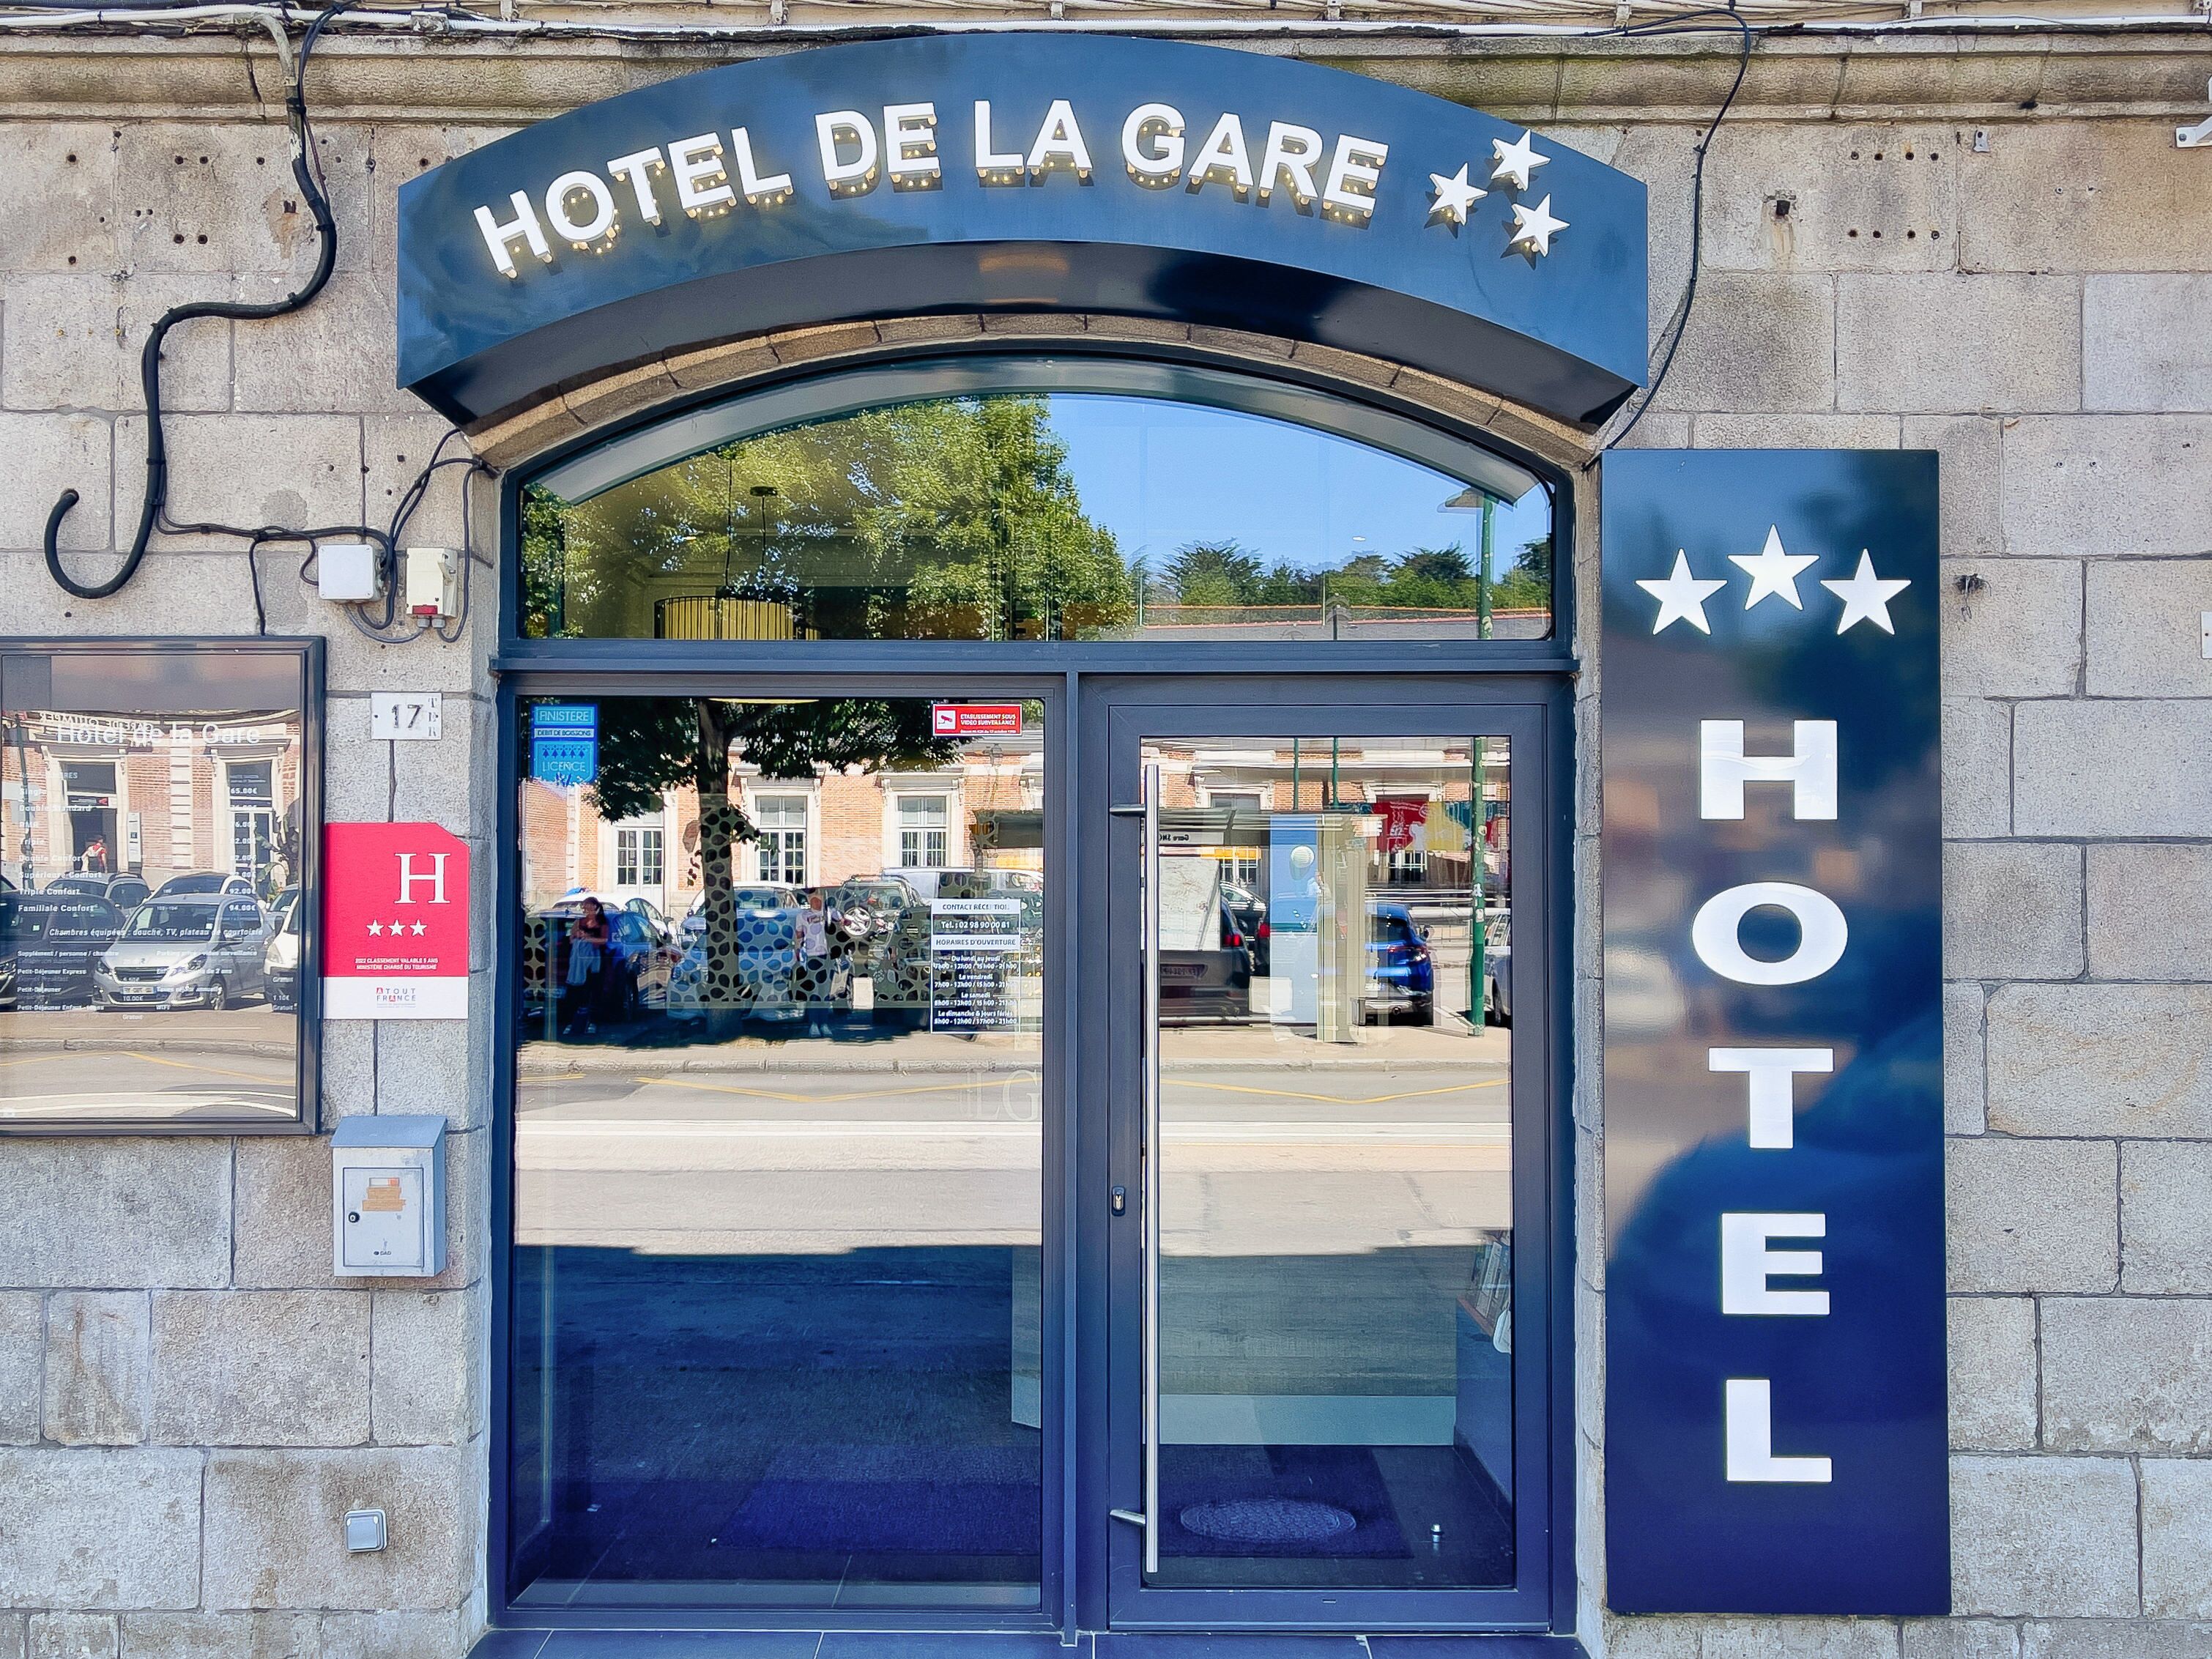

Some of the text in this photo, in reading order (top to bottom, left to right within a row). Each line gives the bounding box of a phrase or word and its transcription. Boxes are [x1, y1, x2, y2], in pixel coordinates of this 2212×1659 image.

[473, 100, 1389, 277] HOTEL DE LA GARE
[391, 704, 423, 728] 17
[539, 710, 589, 721] FINISTERE
[139, 723, 163, 743] de
[172, 723, 192, 743] la
[201, 723, 261, 744] Gare
[542, 762, 586, 772] LICENCE
[394, 853, 451, 904] H
[19, 888, 44, 897] Triple
[90, 928, 125, 937] équipées
[133, 928, 163, 936] douche,
[179, 928, 209, 936] plateau
[1692, 719, 1848, 1482] HOTEL
